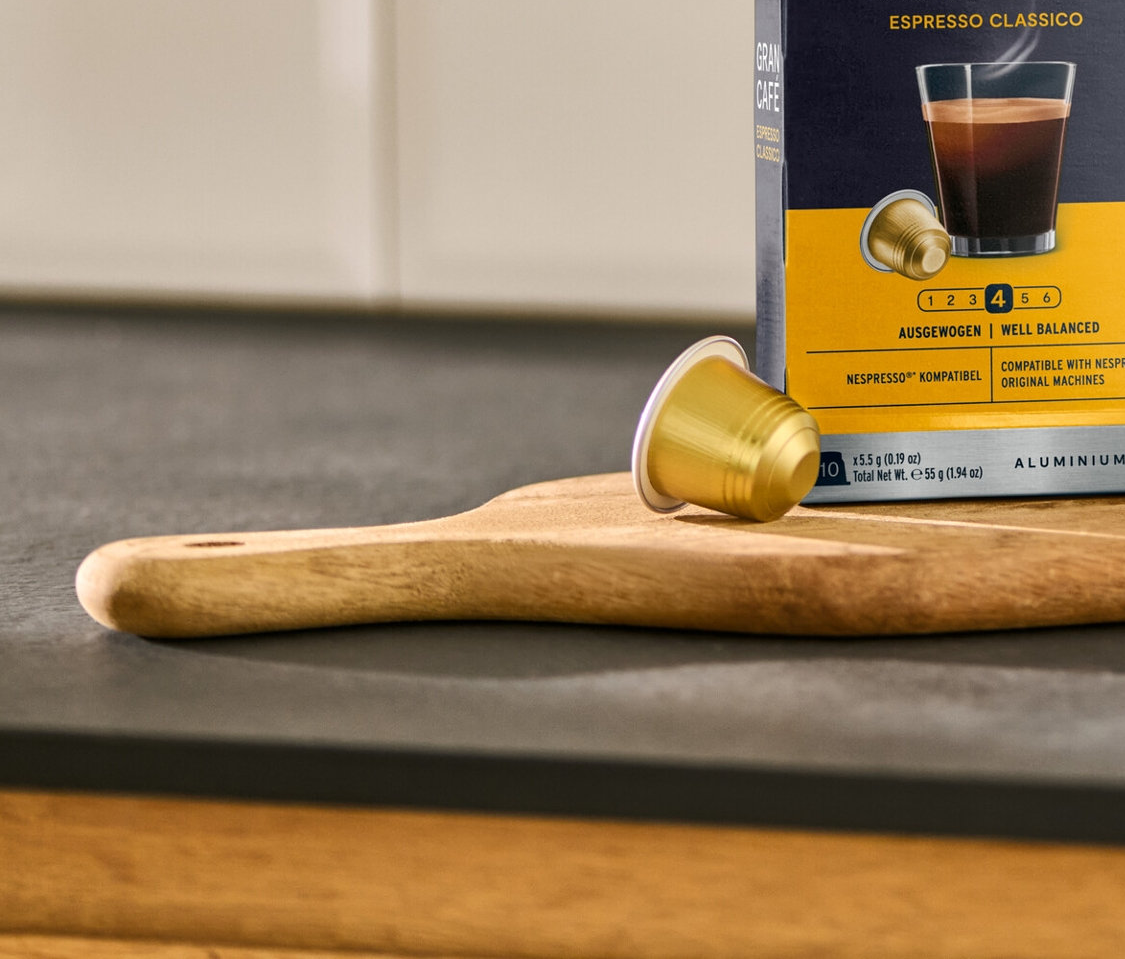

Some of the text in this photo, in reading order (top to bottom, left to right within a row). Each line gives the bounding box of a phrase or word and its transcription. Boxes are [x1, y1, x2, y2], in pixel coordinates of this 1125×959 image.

[889, 11, 1083, 30] ESPRESSO CLASSICO
[756, 42, 780, 73] GRAN
[756, 74, 780, 112] CAFÉ
[756, 124, 780, 143] ESPRESSO
[756, 144, 780, 163] CLASSICO
[928, 289, 1051, 308] 1 2 3 4 5 6
[898, 325, 982, 339] AUSGEWOGEN
[1001, 321, 1101, 336] WELL BALANCED
[1001, 360, 1063, 372] COMPATIBLE
[1066, 359, 1092, 370] WITH
[919, 370, 982, 383] KOMPATIBEL
[1001, 375, 1105, 388] ORIGINAL MACHINES
[876, 456, 882, 468] g
[884, 453, 905, 466] (0.19
[908, 452, 921, 465] oz)
[1014, 454, 1125, 469] ALUMINIUM
[820, 461, 840, 478] 10
[853, 470, 875, 483] Total
[877, 469, 892, 481] Net
[894, 468, 908, 481] Wt.
[938, 470, 944, 482] g
[946, 467, 967, 480] (1.94
[969, 466, 983, 479] oz)
